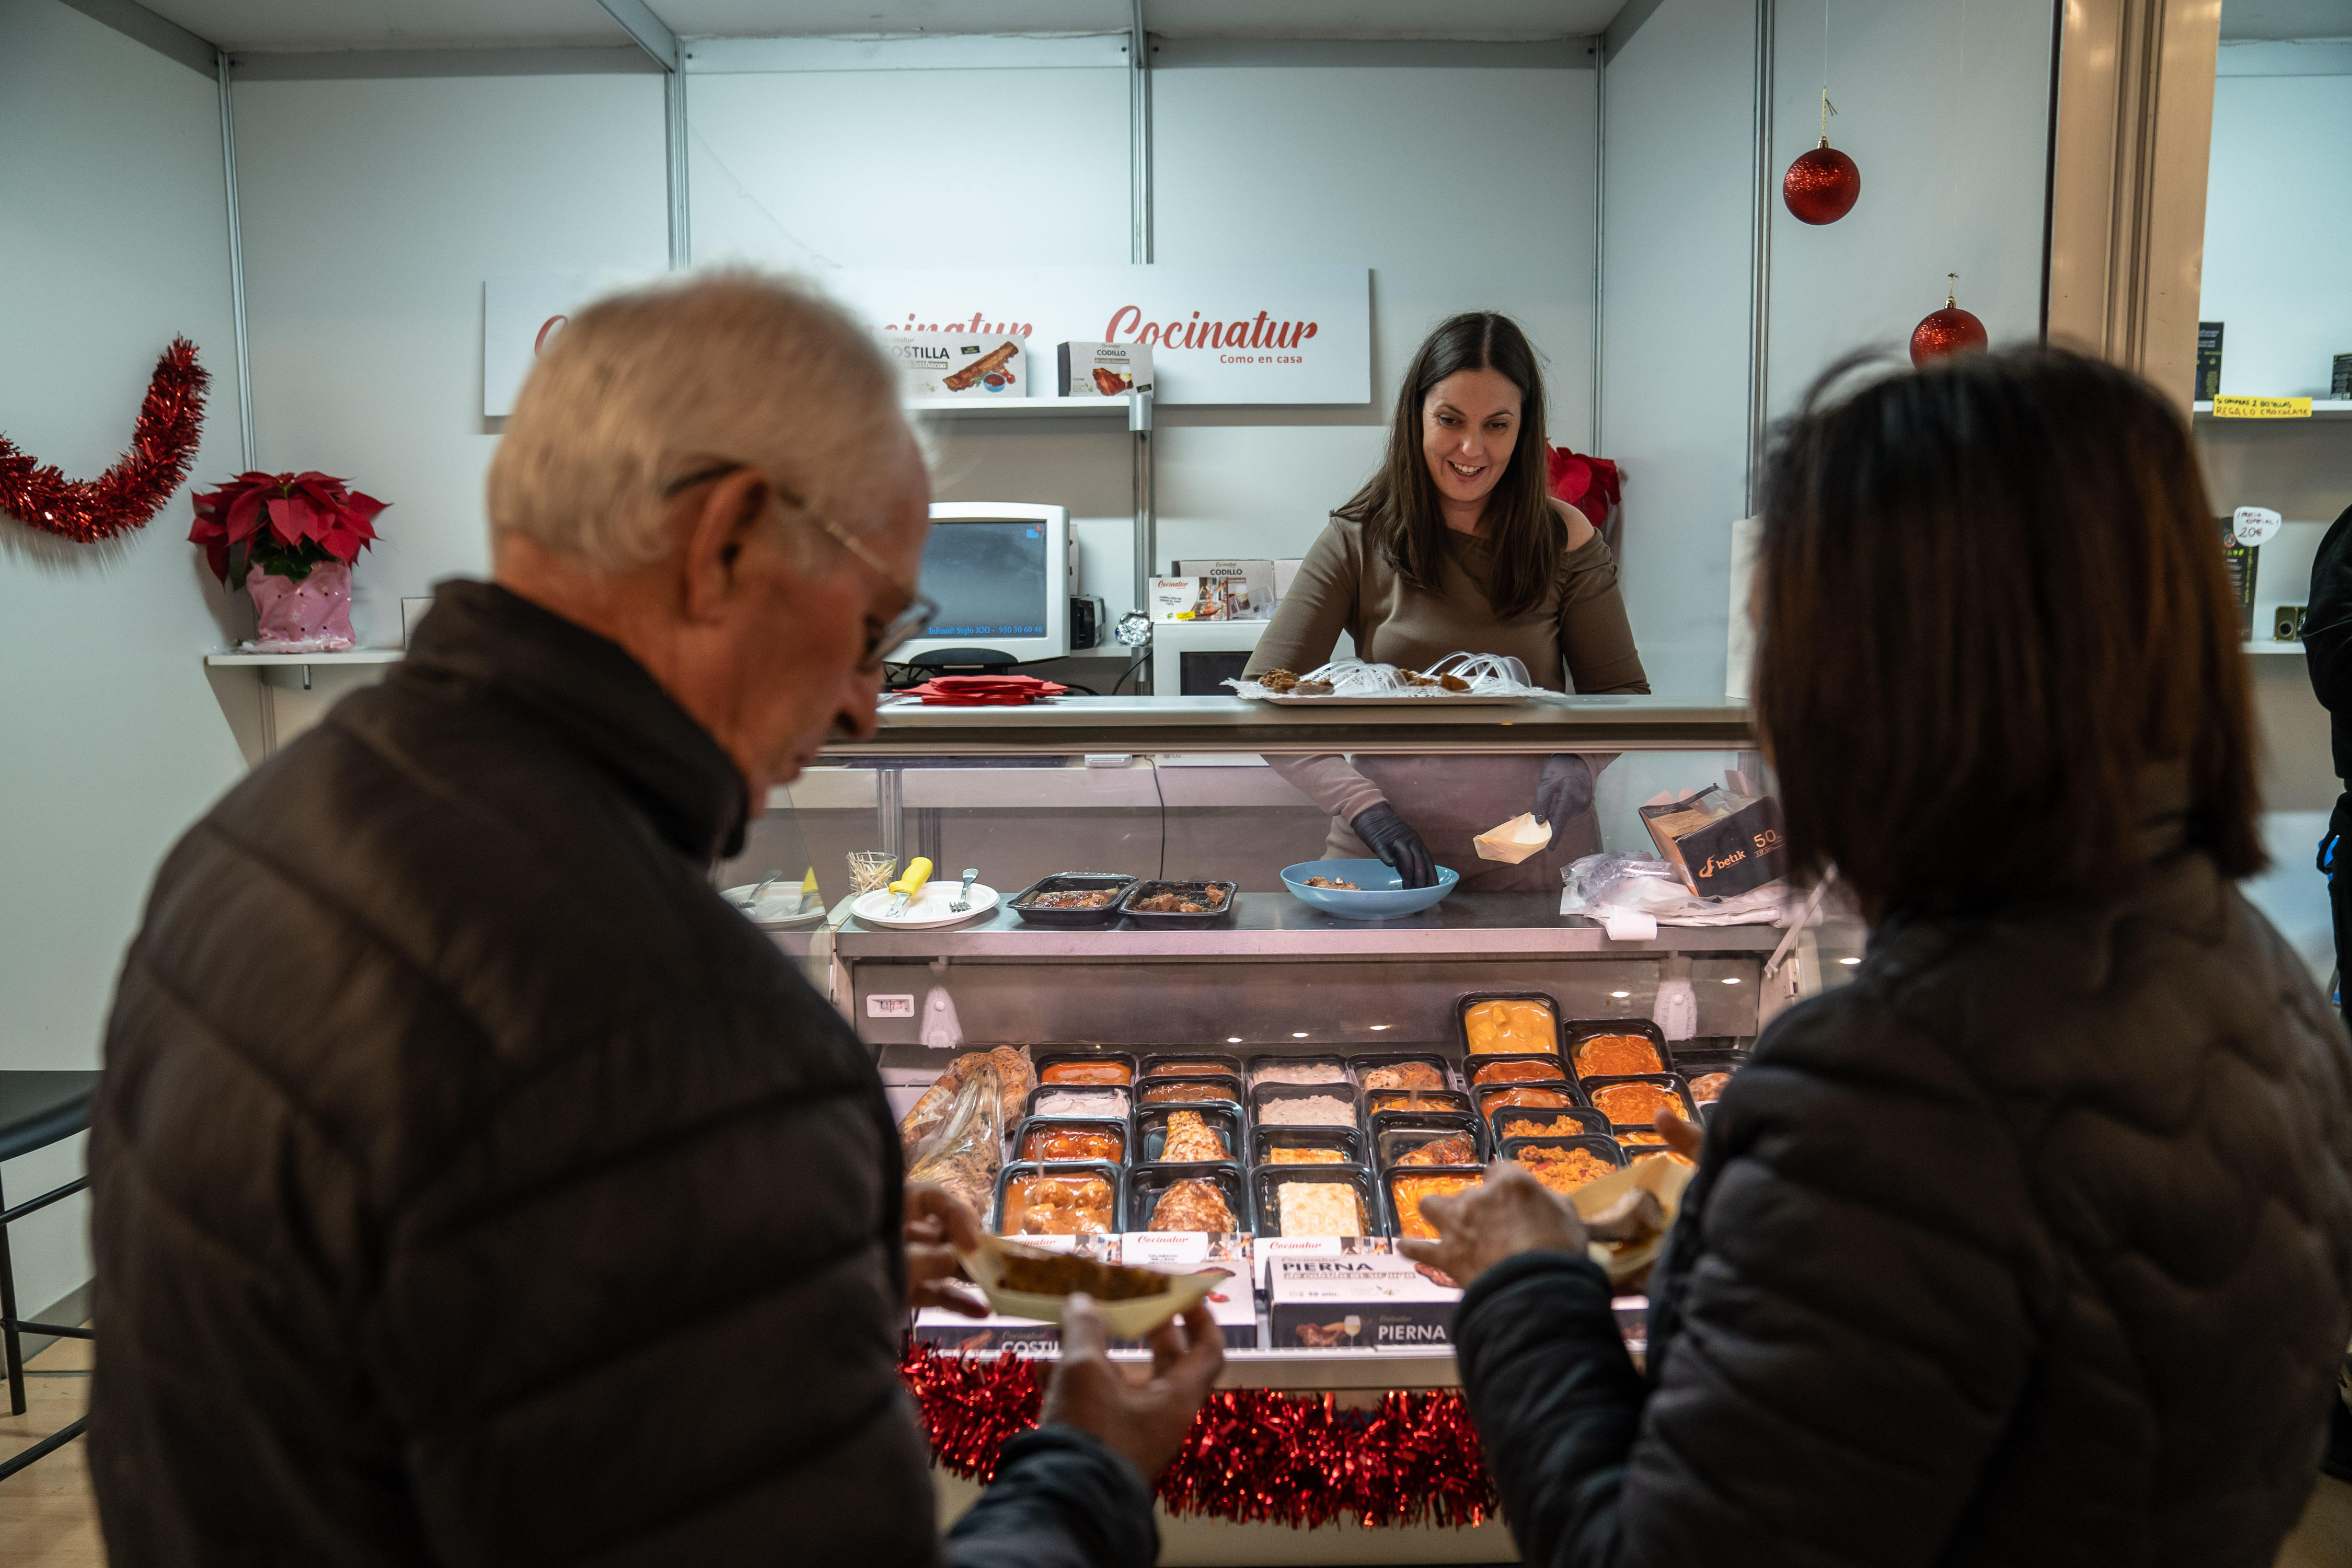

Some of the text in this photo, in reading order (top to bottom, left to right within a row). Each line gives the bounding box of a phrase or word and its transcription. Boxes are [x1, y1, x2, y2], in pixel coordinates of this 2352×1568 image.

[1105, 305, 1318, 349] Cocinatur
[890, 345, 950, 360] OSTILLA
[1220, 354, 1254, 364] Como
[914, 360, 948, 369] barbacoa
[2216, 407, 2256, 416] REGALO
[2238, 526, 2262, 537] 20€
[1158, 580, 1189, 589] Cocinatur
[956, 627, 974, 636] Siglo
[1754, 829, 1776, 848] 50
[1715, 850, 1746, 869] betik
[1138, 1235, 1189, 1243] Cocinatur
[1270, 1241, 1321, 1250] Cocinatur
[1283, 1263, 1373, 1271] PIERNA
[1378, 1324, 1446, 1341] PIERNA
